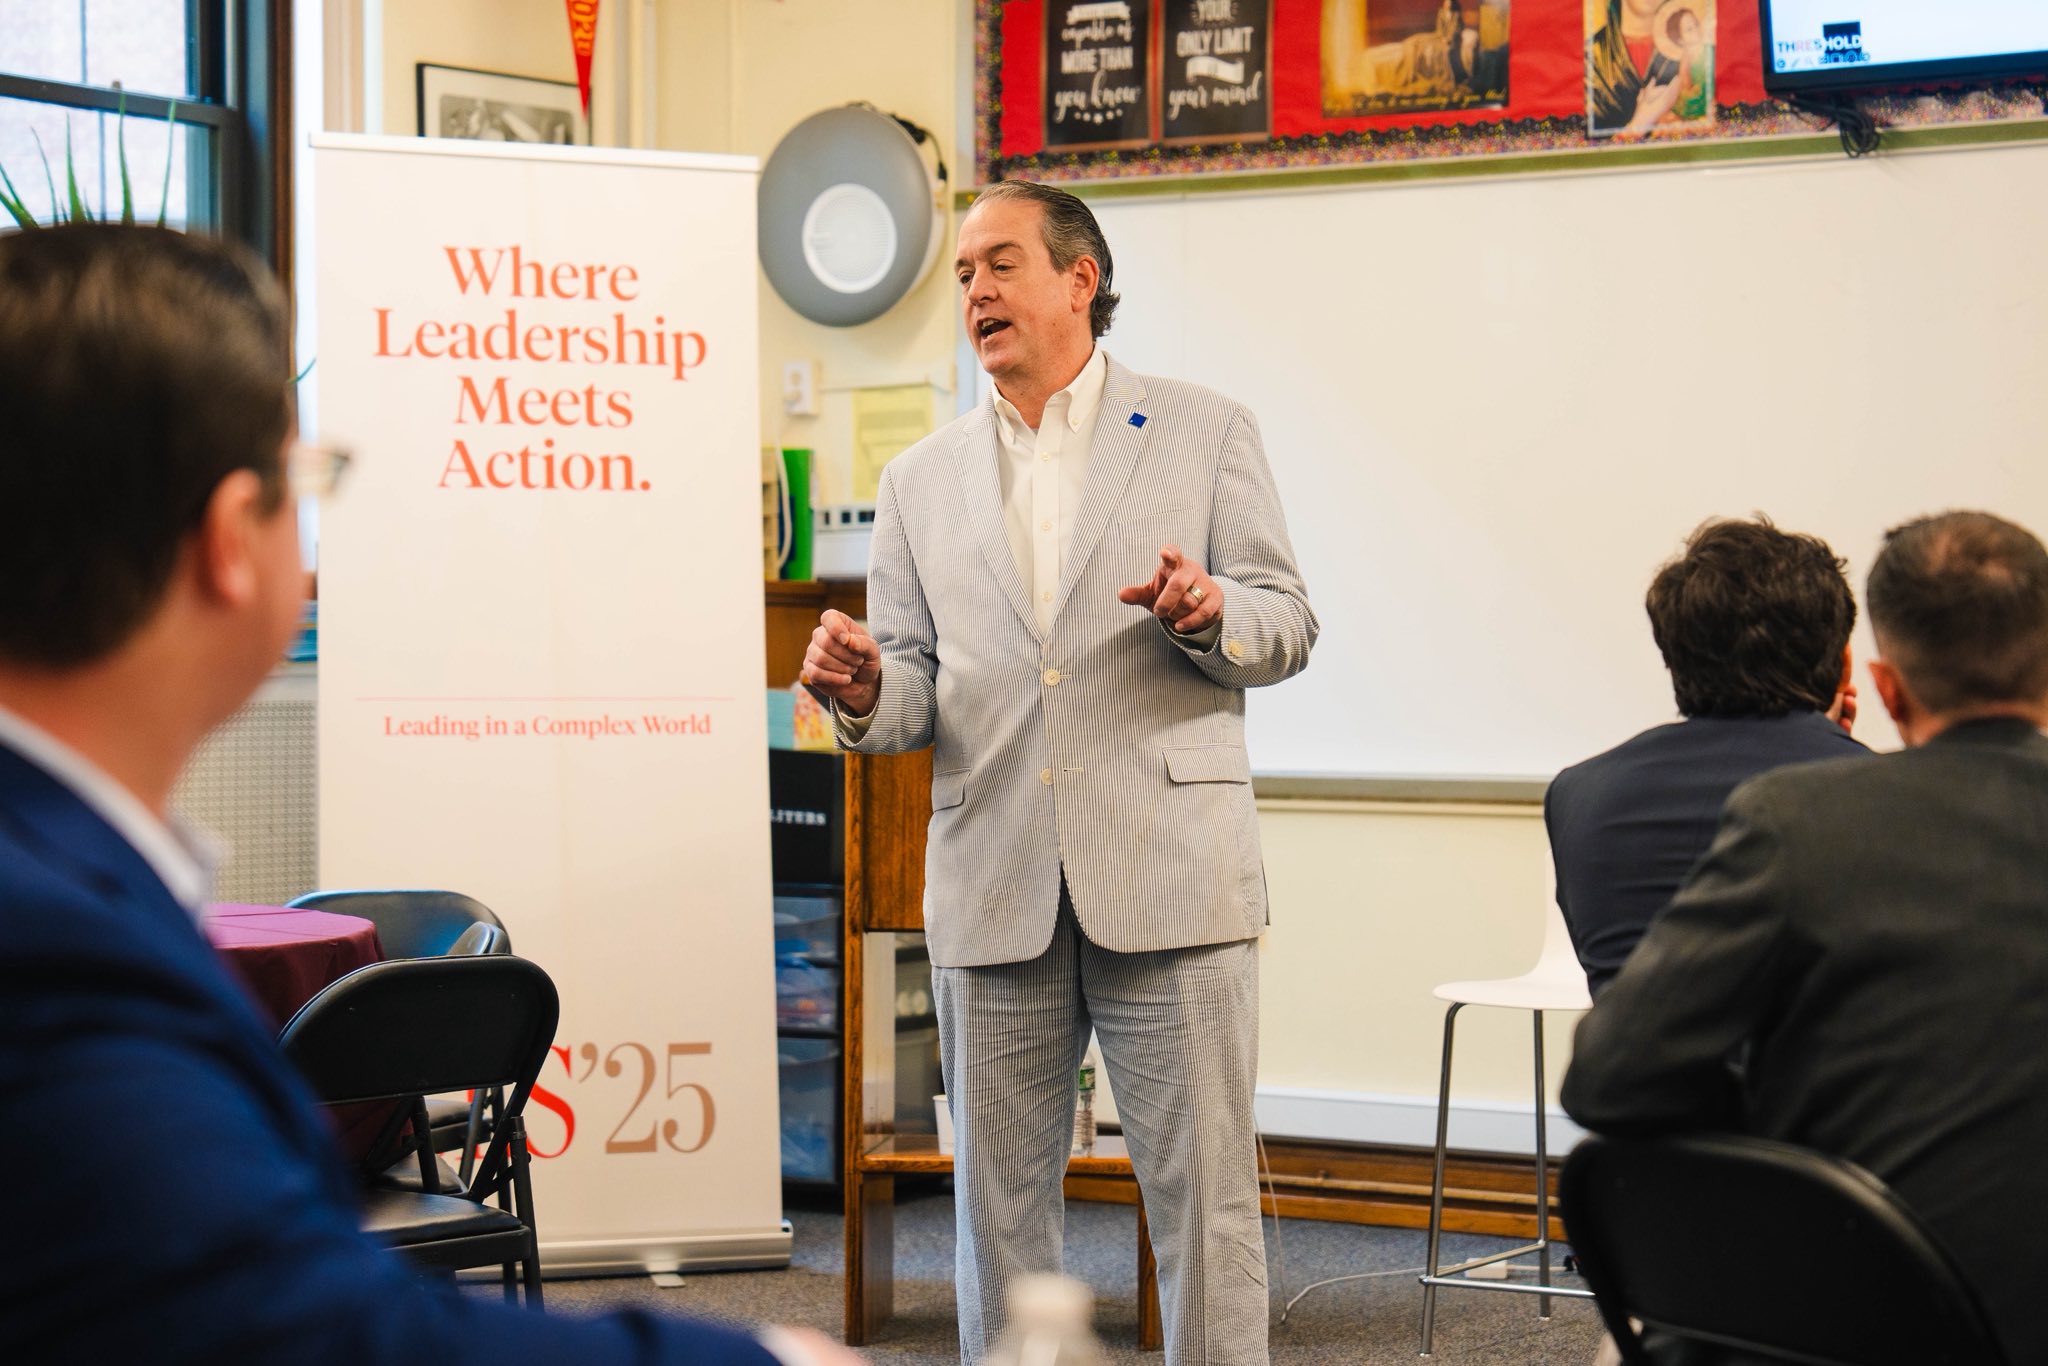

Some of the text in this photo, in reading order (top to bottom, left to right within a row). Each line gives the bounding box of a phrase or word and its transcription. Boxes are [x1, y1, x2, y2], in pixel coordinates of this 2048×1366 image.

[1061, 46, 1134, 74] MORE THAN
[1176, 26, 1253, 57] ONLY LIMIT
[1776, 34, 1863, 54] THRESHOLD
[1053, 87, 1087, 124] you
[1167, 85, 1207, 121] your
[443, 244, 639, 302] Where
[372, 307, 708, 382] Leadership
[454, 375, 634, 428] Meets
[437, 438, 652, 492] Action.
[384, 712, 713, 741] Leading in a Complex World
[456, 1041, 716, 1159] S’25
